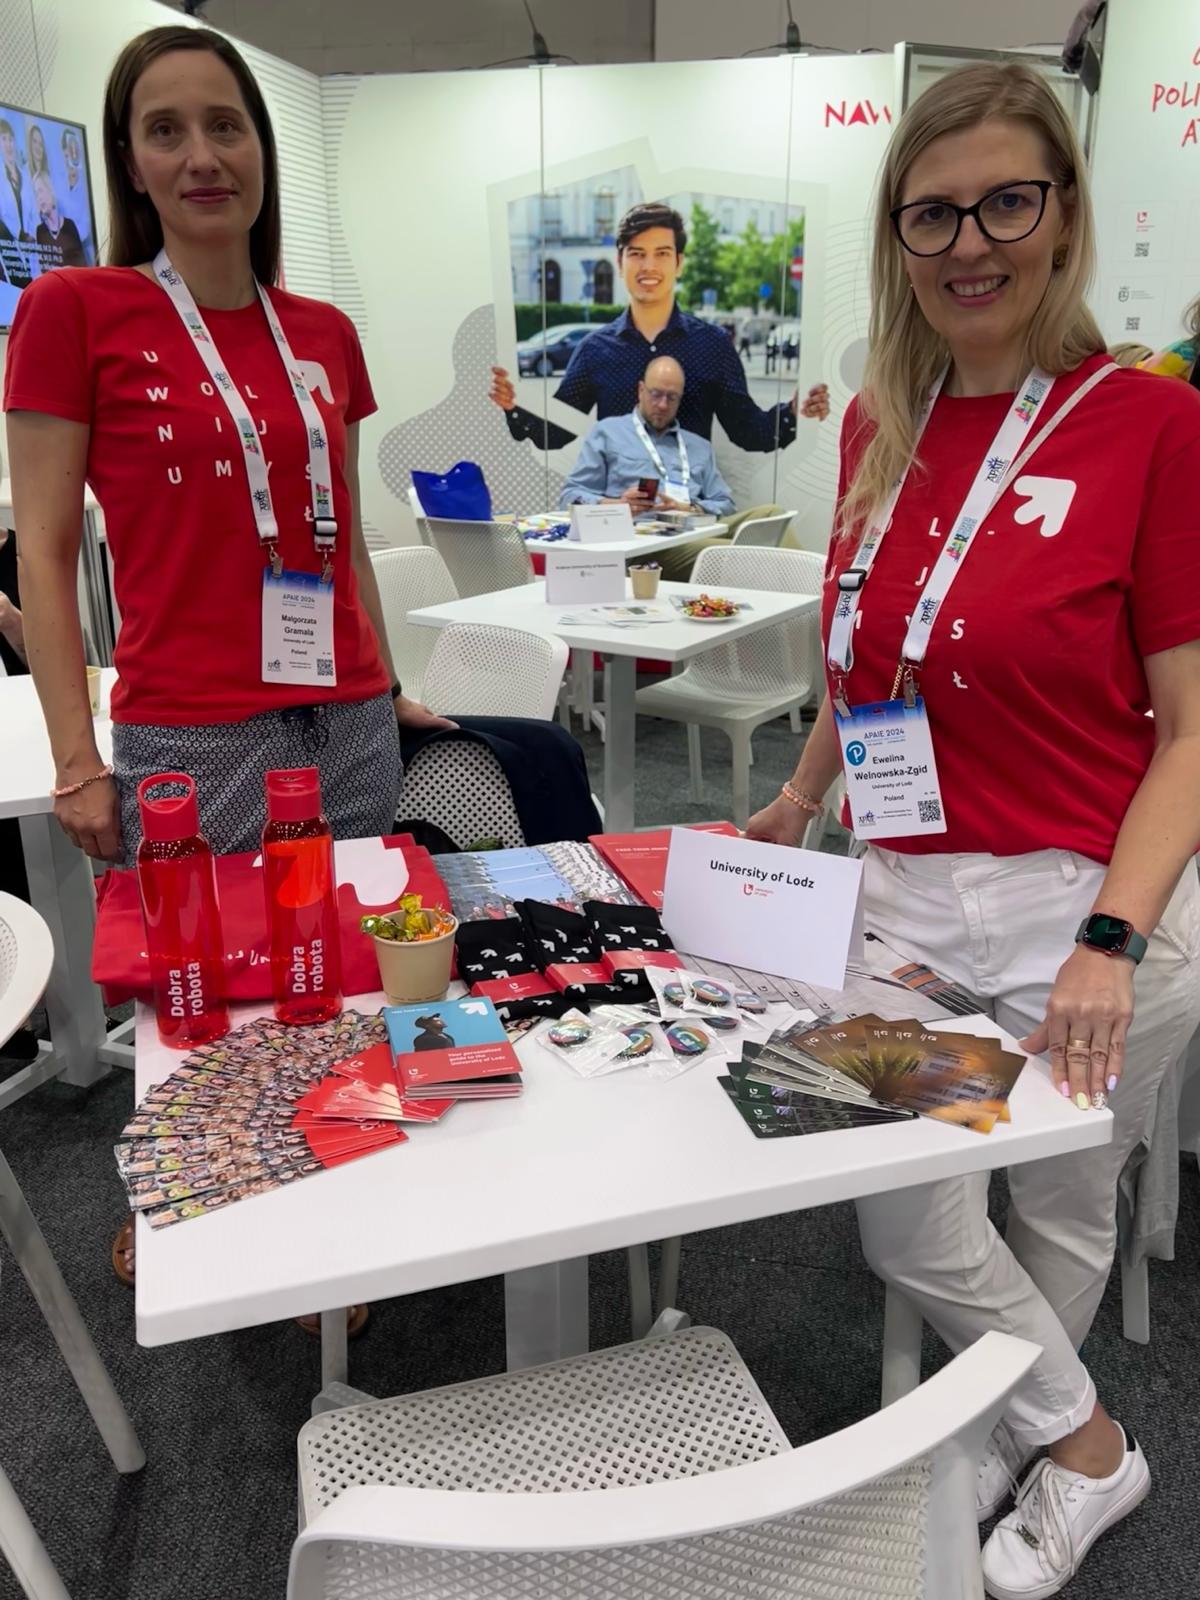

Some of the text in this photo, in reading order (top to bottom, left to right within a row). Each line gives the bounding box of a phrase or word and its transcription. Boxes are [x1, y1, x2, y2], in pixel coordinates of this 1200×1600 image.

[281, 614, 317, 625] Malgorzata
[284, 626, 314, 636] Gramala
[863, 728, 904, 740] APAIE 2024
[872, 754, 905, 765] Ewelina
[854, 765, 928, 781] Welnowska-Zgid
[884, 794, 904, 802] Poland
[710, 860, 815, 888] University of Lodz
[290, 946, 306, 993] Dobra
[309, 939, 324, 992] robota
[168, 969, 185, 1017] Dobra
[186, 962, 204, 1016] robota
